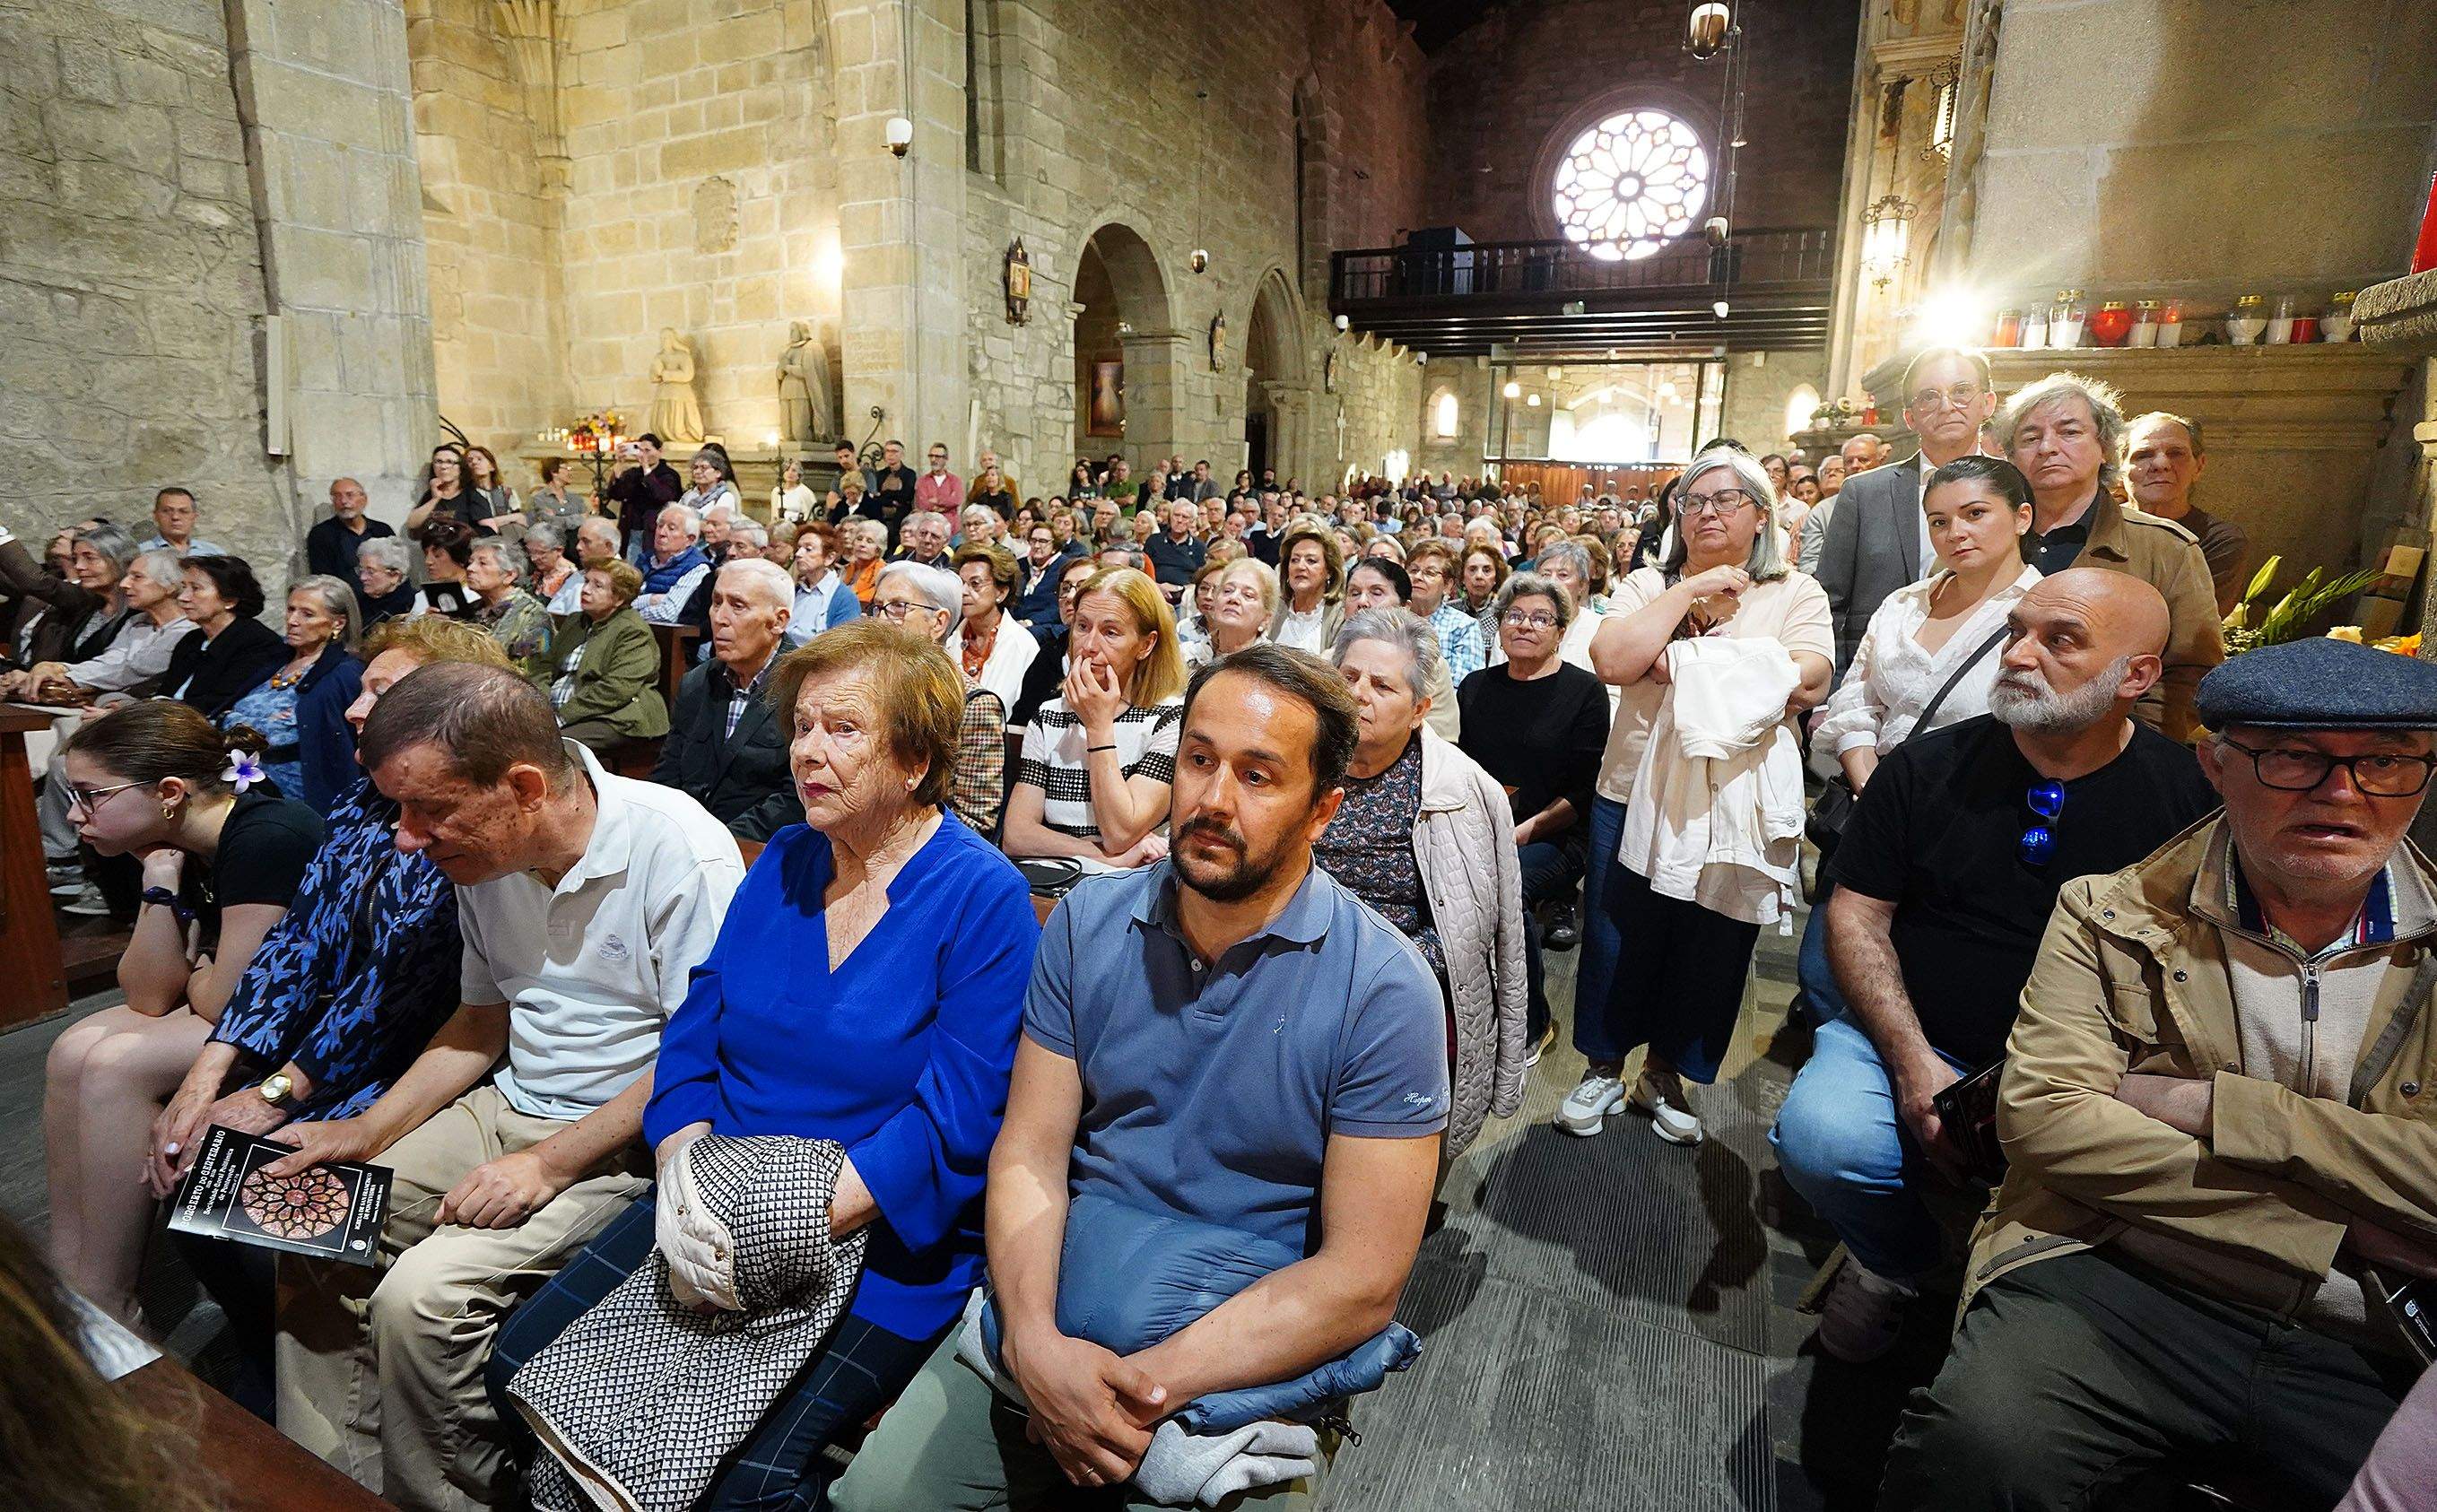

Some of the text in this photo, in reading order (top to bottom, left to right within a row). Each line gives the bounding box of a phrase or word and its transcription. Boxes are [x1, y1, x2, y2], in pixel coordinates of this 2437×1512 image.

[201, 1129, 226, 1176] CENTENARIO
[198, 1175, 207, 1185] DO
[213, 1172, 223, 1187] Coral
[220, 1163, 236, 1193] Pontevedra
[218, 1193, 224, 1201] de
